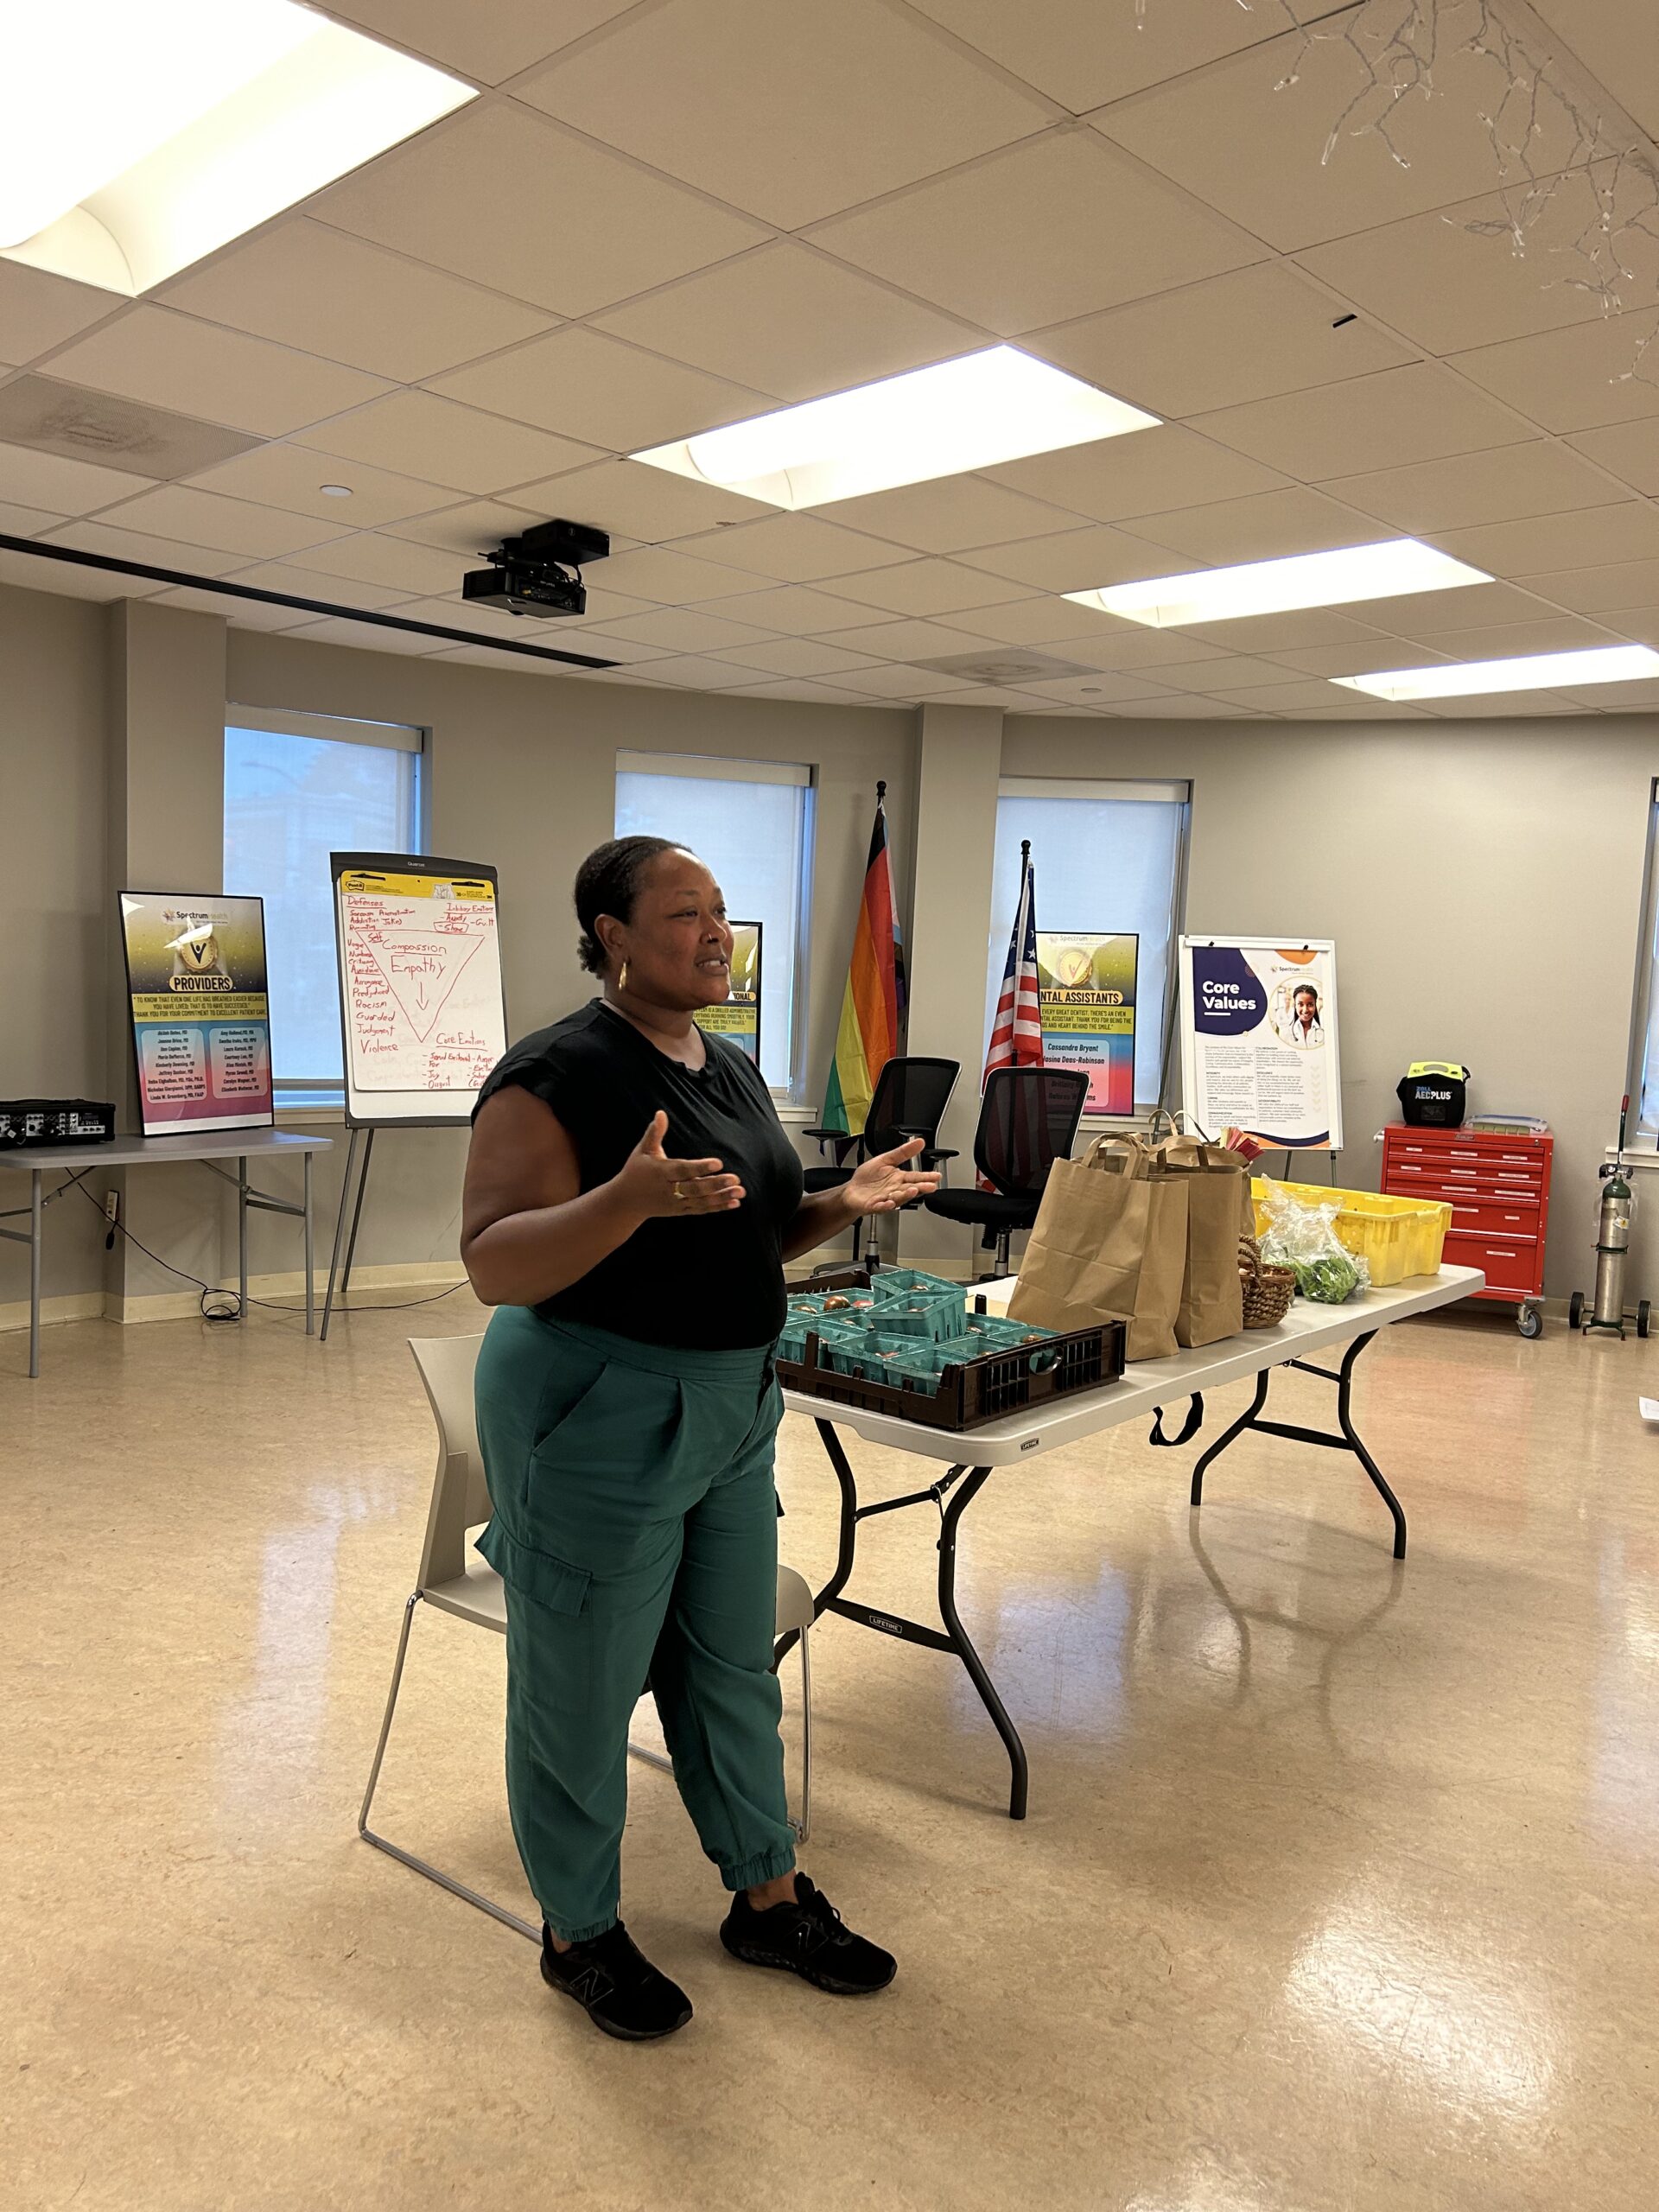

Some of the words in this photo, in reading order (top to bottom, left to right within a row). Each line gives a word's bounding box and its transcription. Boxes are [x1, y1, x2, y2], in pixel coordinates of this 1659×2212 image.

[348, 896, 384, 906] Defenses
[176, 911, 208, 920] Spectrum
[382, 939, 447, 954] Compassion
[391, 955, 446, 980] Empathy
[174, 977, 231, 991] PROVIDERS
[1202, 981, 1240, 994] Core
[356, 999, 387, 1008] Racism
[1041, 991, 1063, 1002] NTAL
[1065, 992, 1119, 1004] ASSISTANTS
[1202, 996, 1257, 1010] Values
[356, 1011, 395, 1022] Guarded
[436, 1033, 456, 1044] Core
[361, 1038, 399, 1054] Violence
[1079, 1044, 1099, 1053] Bryant
[1062, 1056, 1105, 1064] Deas-Robinson
[427, 1070, 439, 1080] Joy
[873, 1617, 899, 1631] LIFETIME
